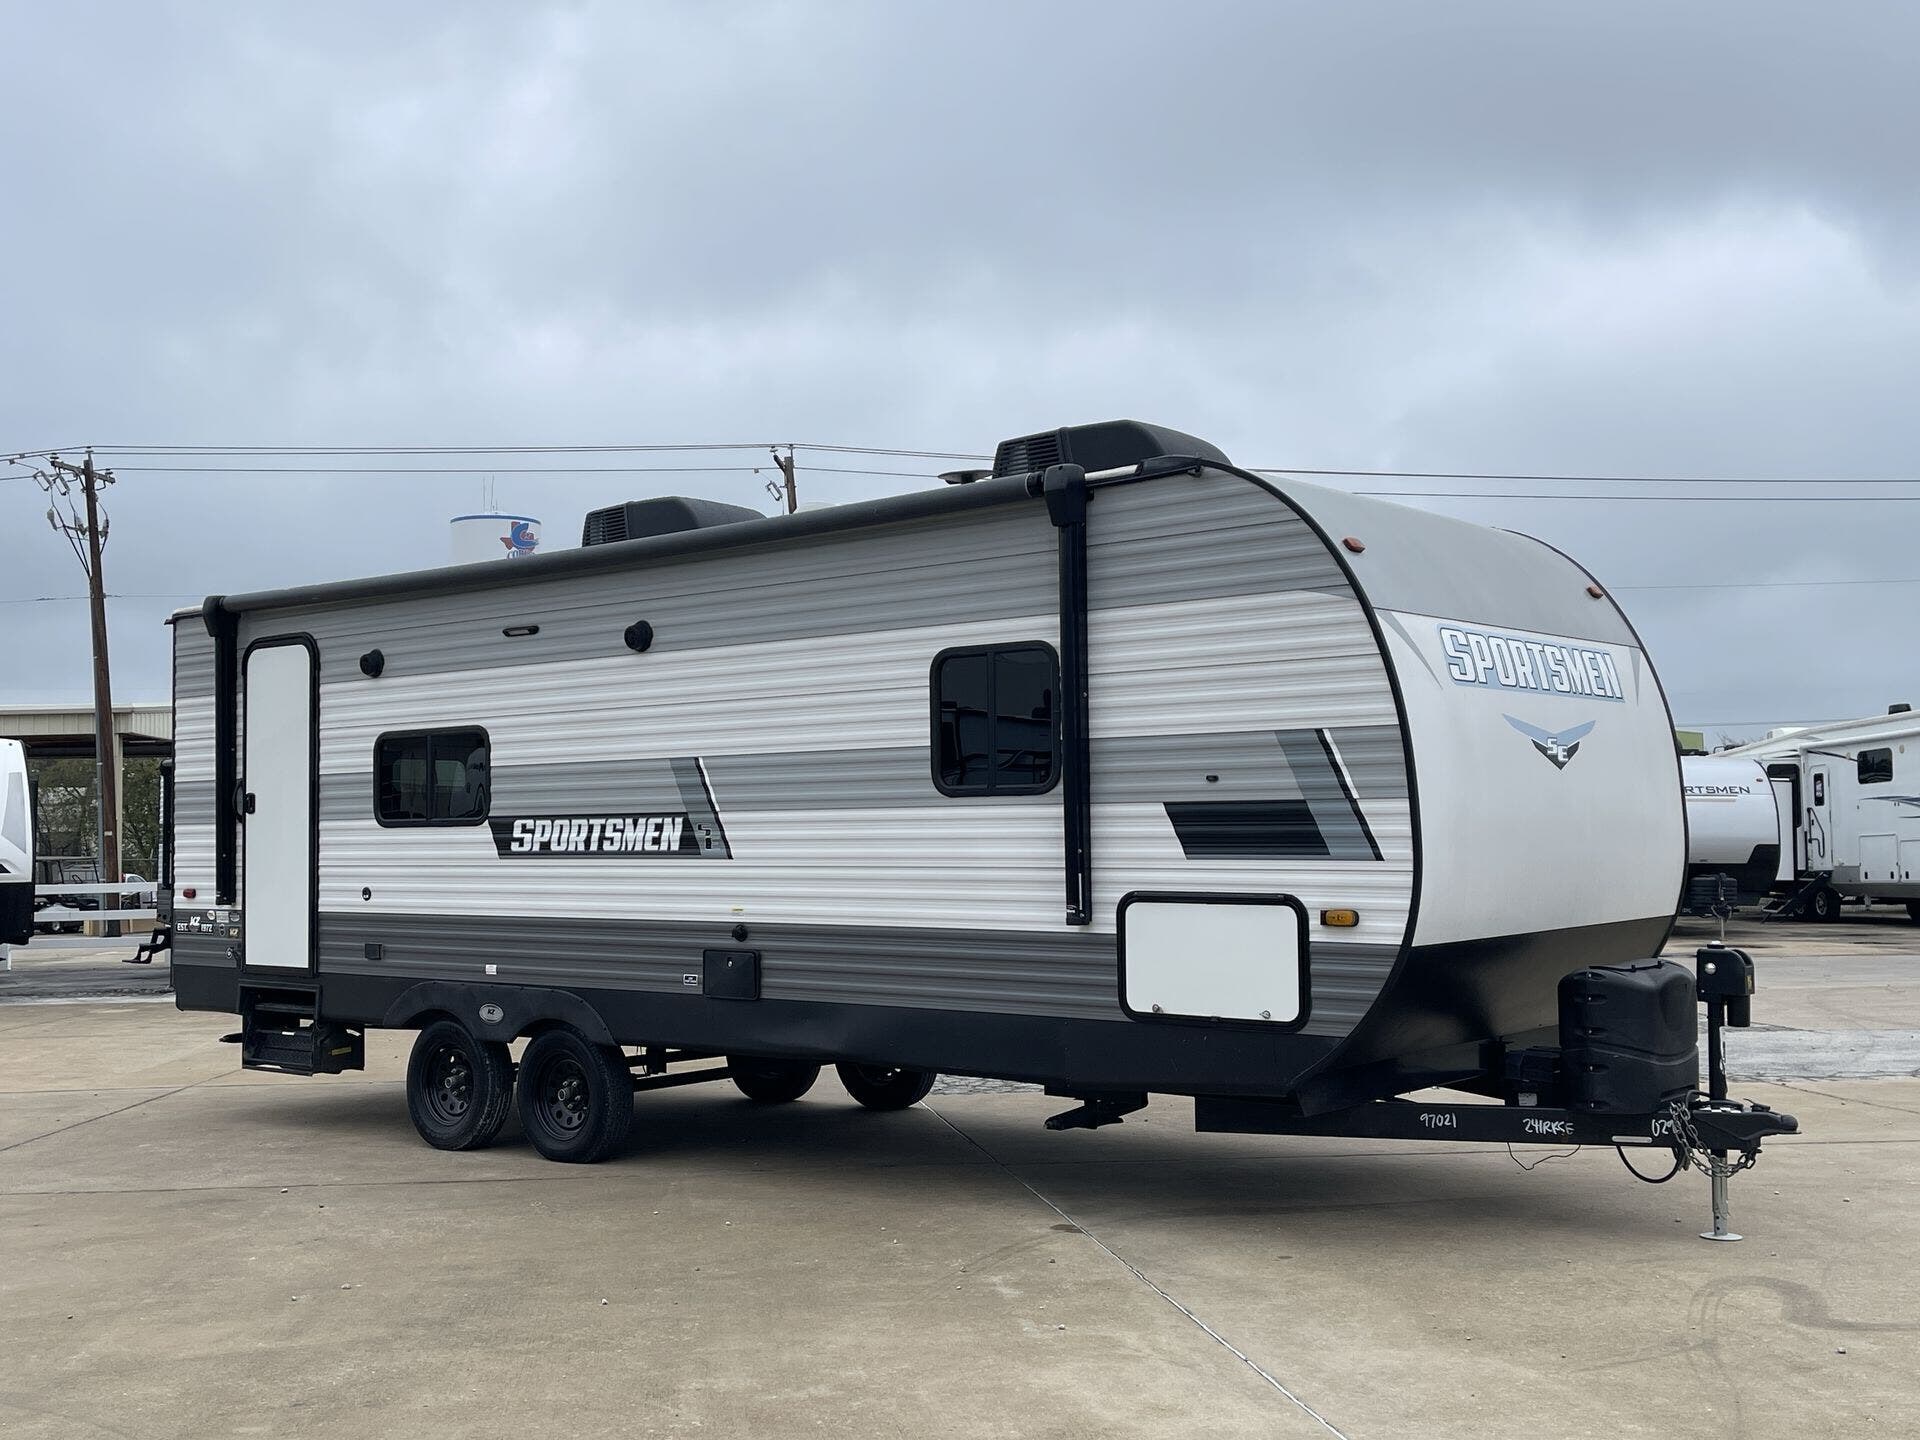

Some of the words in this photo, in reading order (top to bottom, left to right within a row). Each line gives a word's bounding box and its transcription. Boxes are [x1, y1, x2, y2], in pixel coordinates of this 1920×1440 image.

[1439, 627, 1624, 700] SPORTSMEN
[1547, 737, 1569, 761] SE
[510, 816, 684, 852] SPORTSMEN
[1420, 1112, 1457, 1128] 97021
